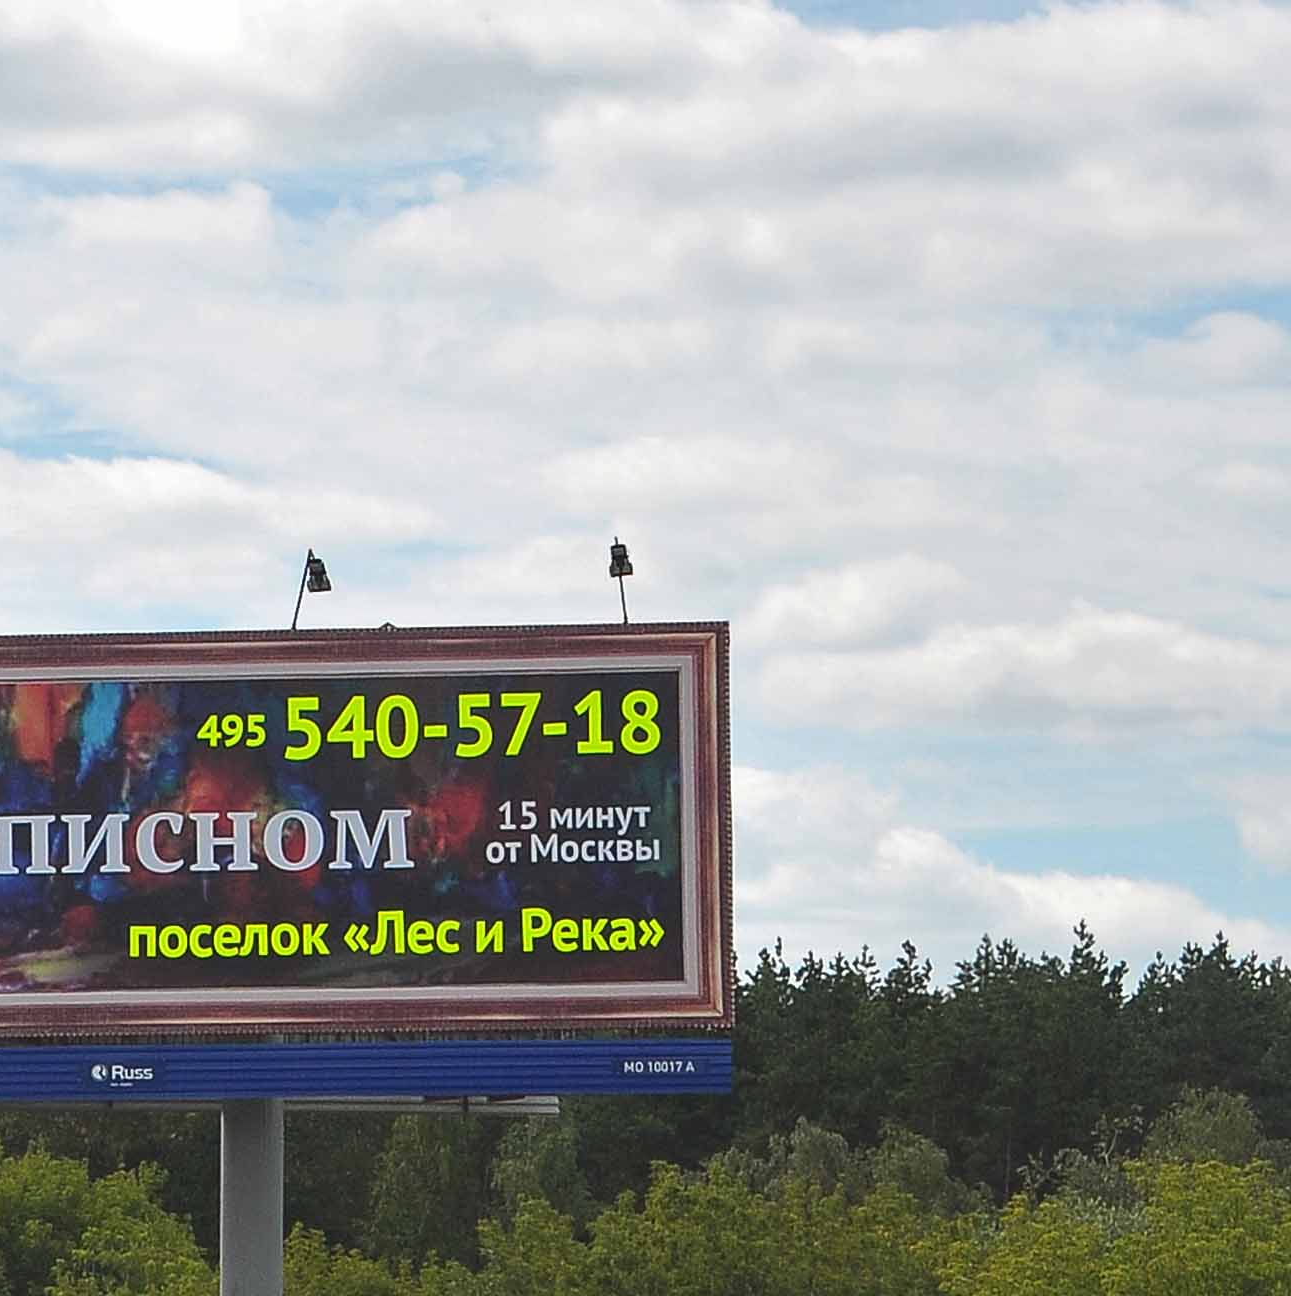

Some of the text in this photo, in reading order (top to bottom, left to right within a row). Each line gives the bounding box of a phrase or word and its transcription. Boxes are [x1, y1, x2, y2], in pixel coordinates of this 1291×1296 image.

[196, 690, 662, 761] 495 540-57-18
[498, 802, 651, 838] 15 минут
[486, 832, 661, 864] от Москвы
[129, 907, 665, 959] поселок «Лес и Река»
[111, 1064, 154, 1081] Russ
[648, 1060, 683, 1073] 10017
